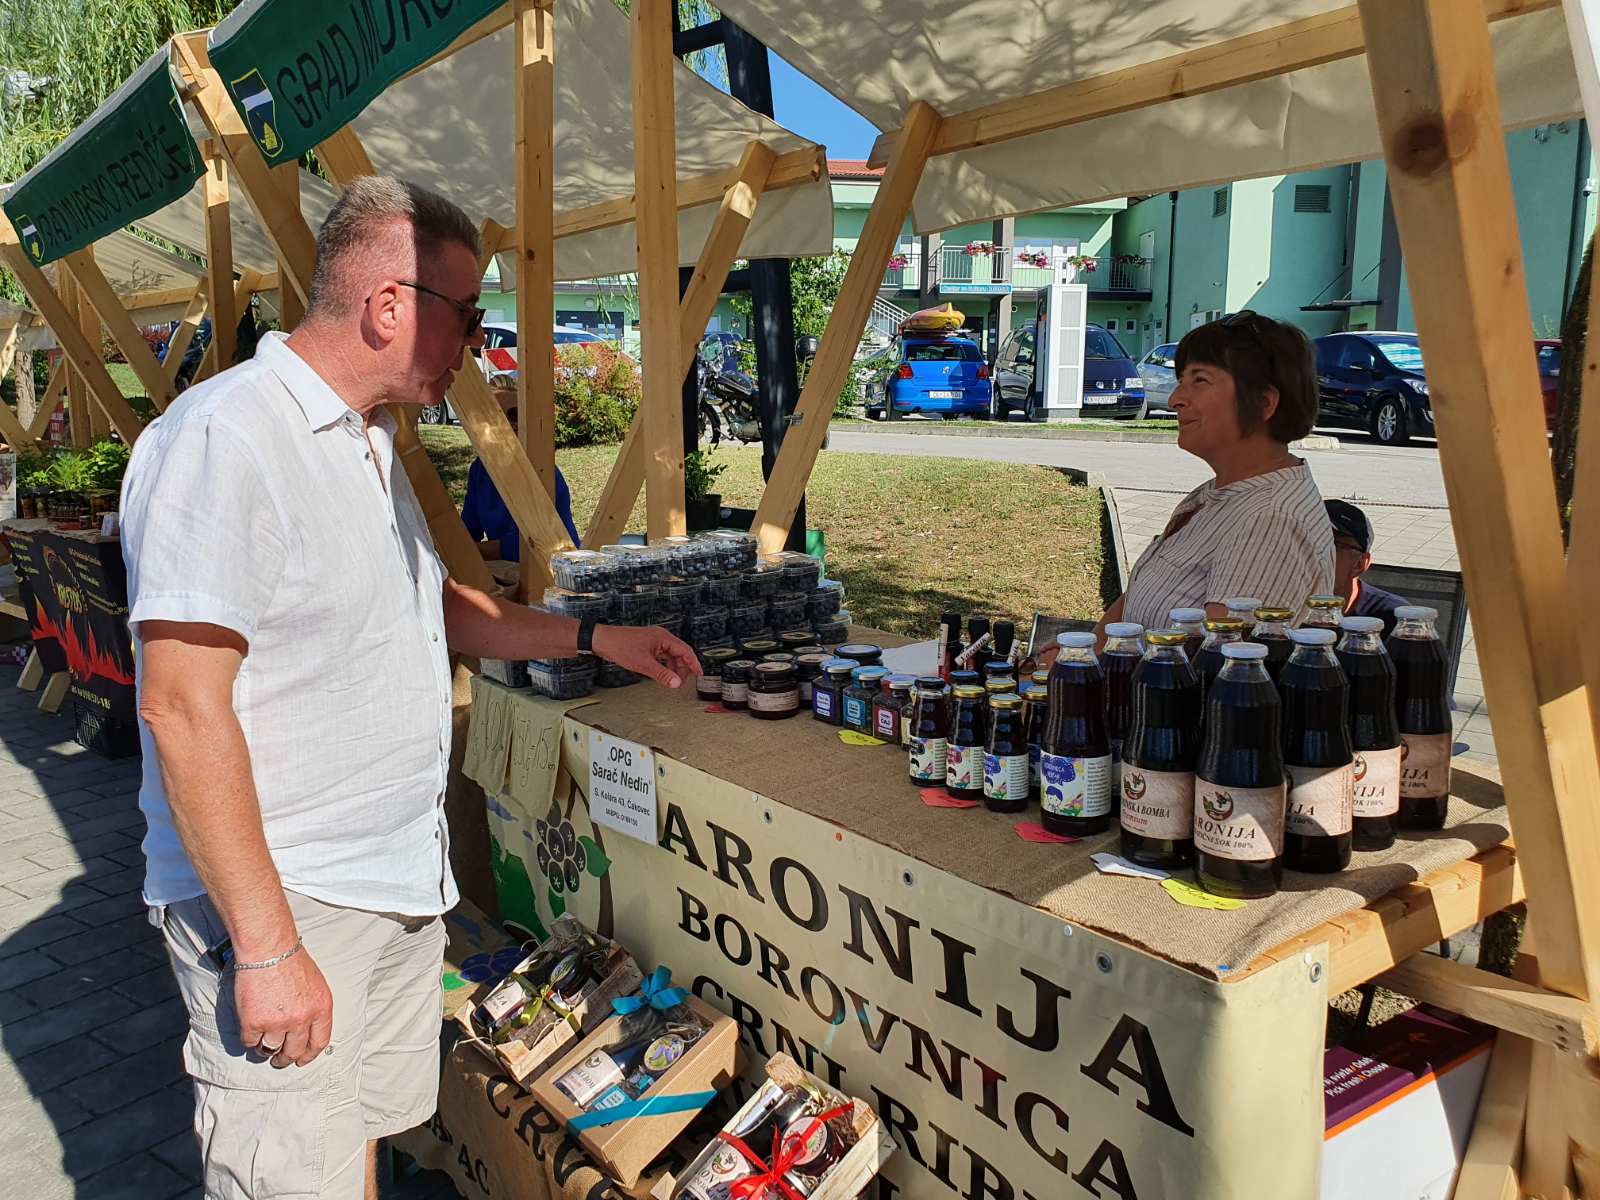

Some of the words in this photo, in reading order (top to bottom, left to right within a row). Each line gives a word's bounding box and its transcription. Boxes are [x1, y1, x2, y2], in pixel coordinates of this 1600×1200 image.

[276, 23, 362, 129] GRAD
[592, 761, 618, 783] Sarač
[627, 797, 651, 816] Čakovec
[1141, 804, 1171, 819] BOMBA
[661, 802, 1194, 1137] ARONIJA
[677, 886, 1138, 1200] BOROVNICA
